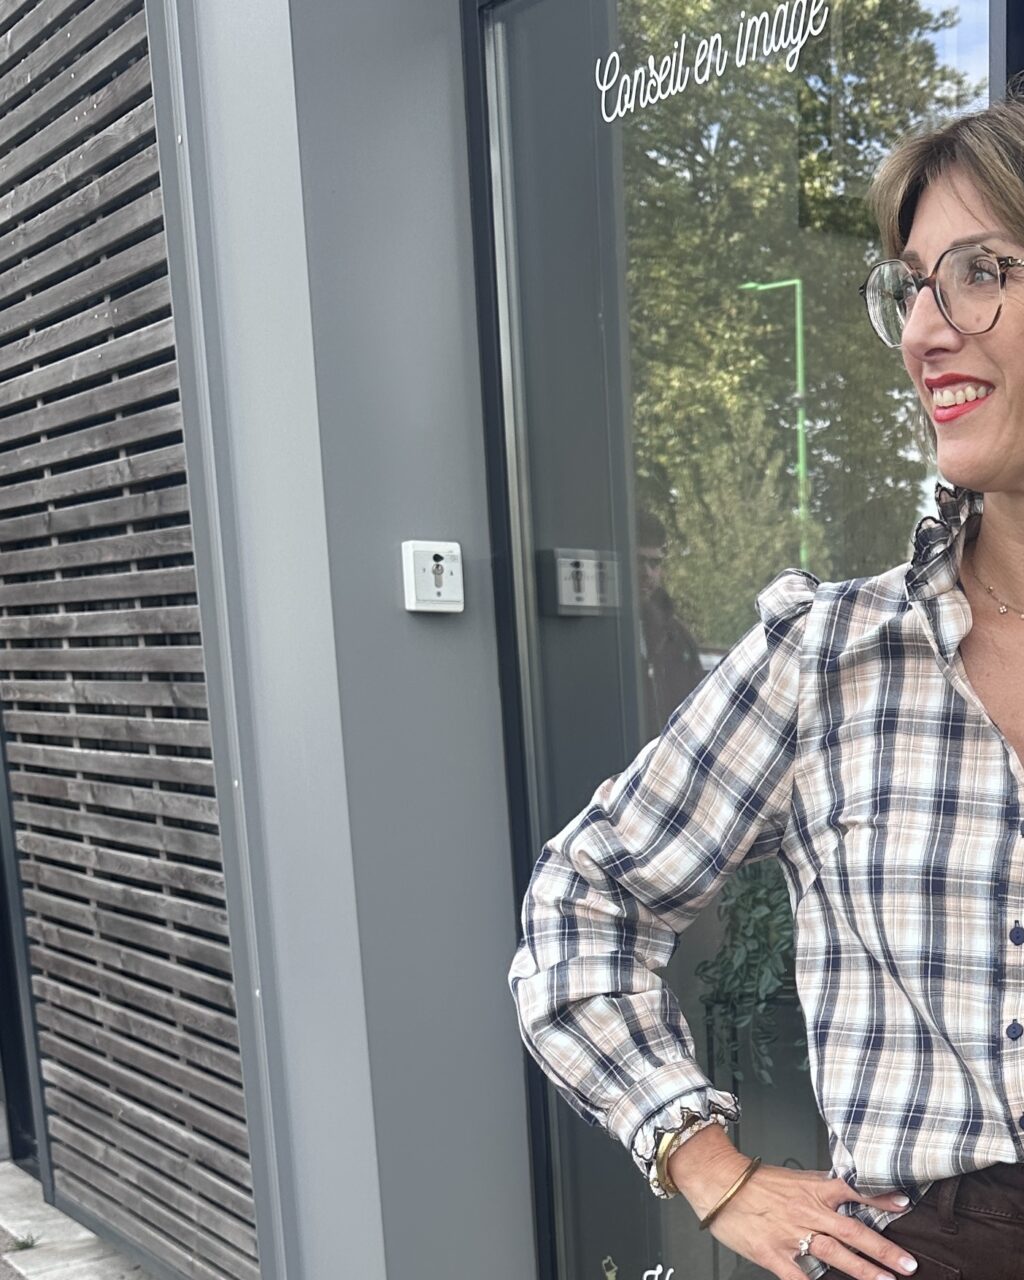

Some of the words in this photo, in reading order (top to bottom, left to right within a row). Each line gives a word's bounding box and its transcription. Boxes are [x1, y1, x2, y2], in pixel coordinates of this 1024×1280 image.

[595, 33, 690, 123] Conseil
[694, 32, 728, 84] en
[735, 0, 829, 72] image
